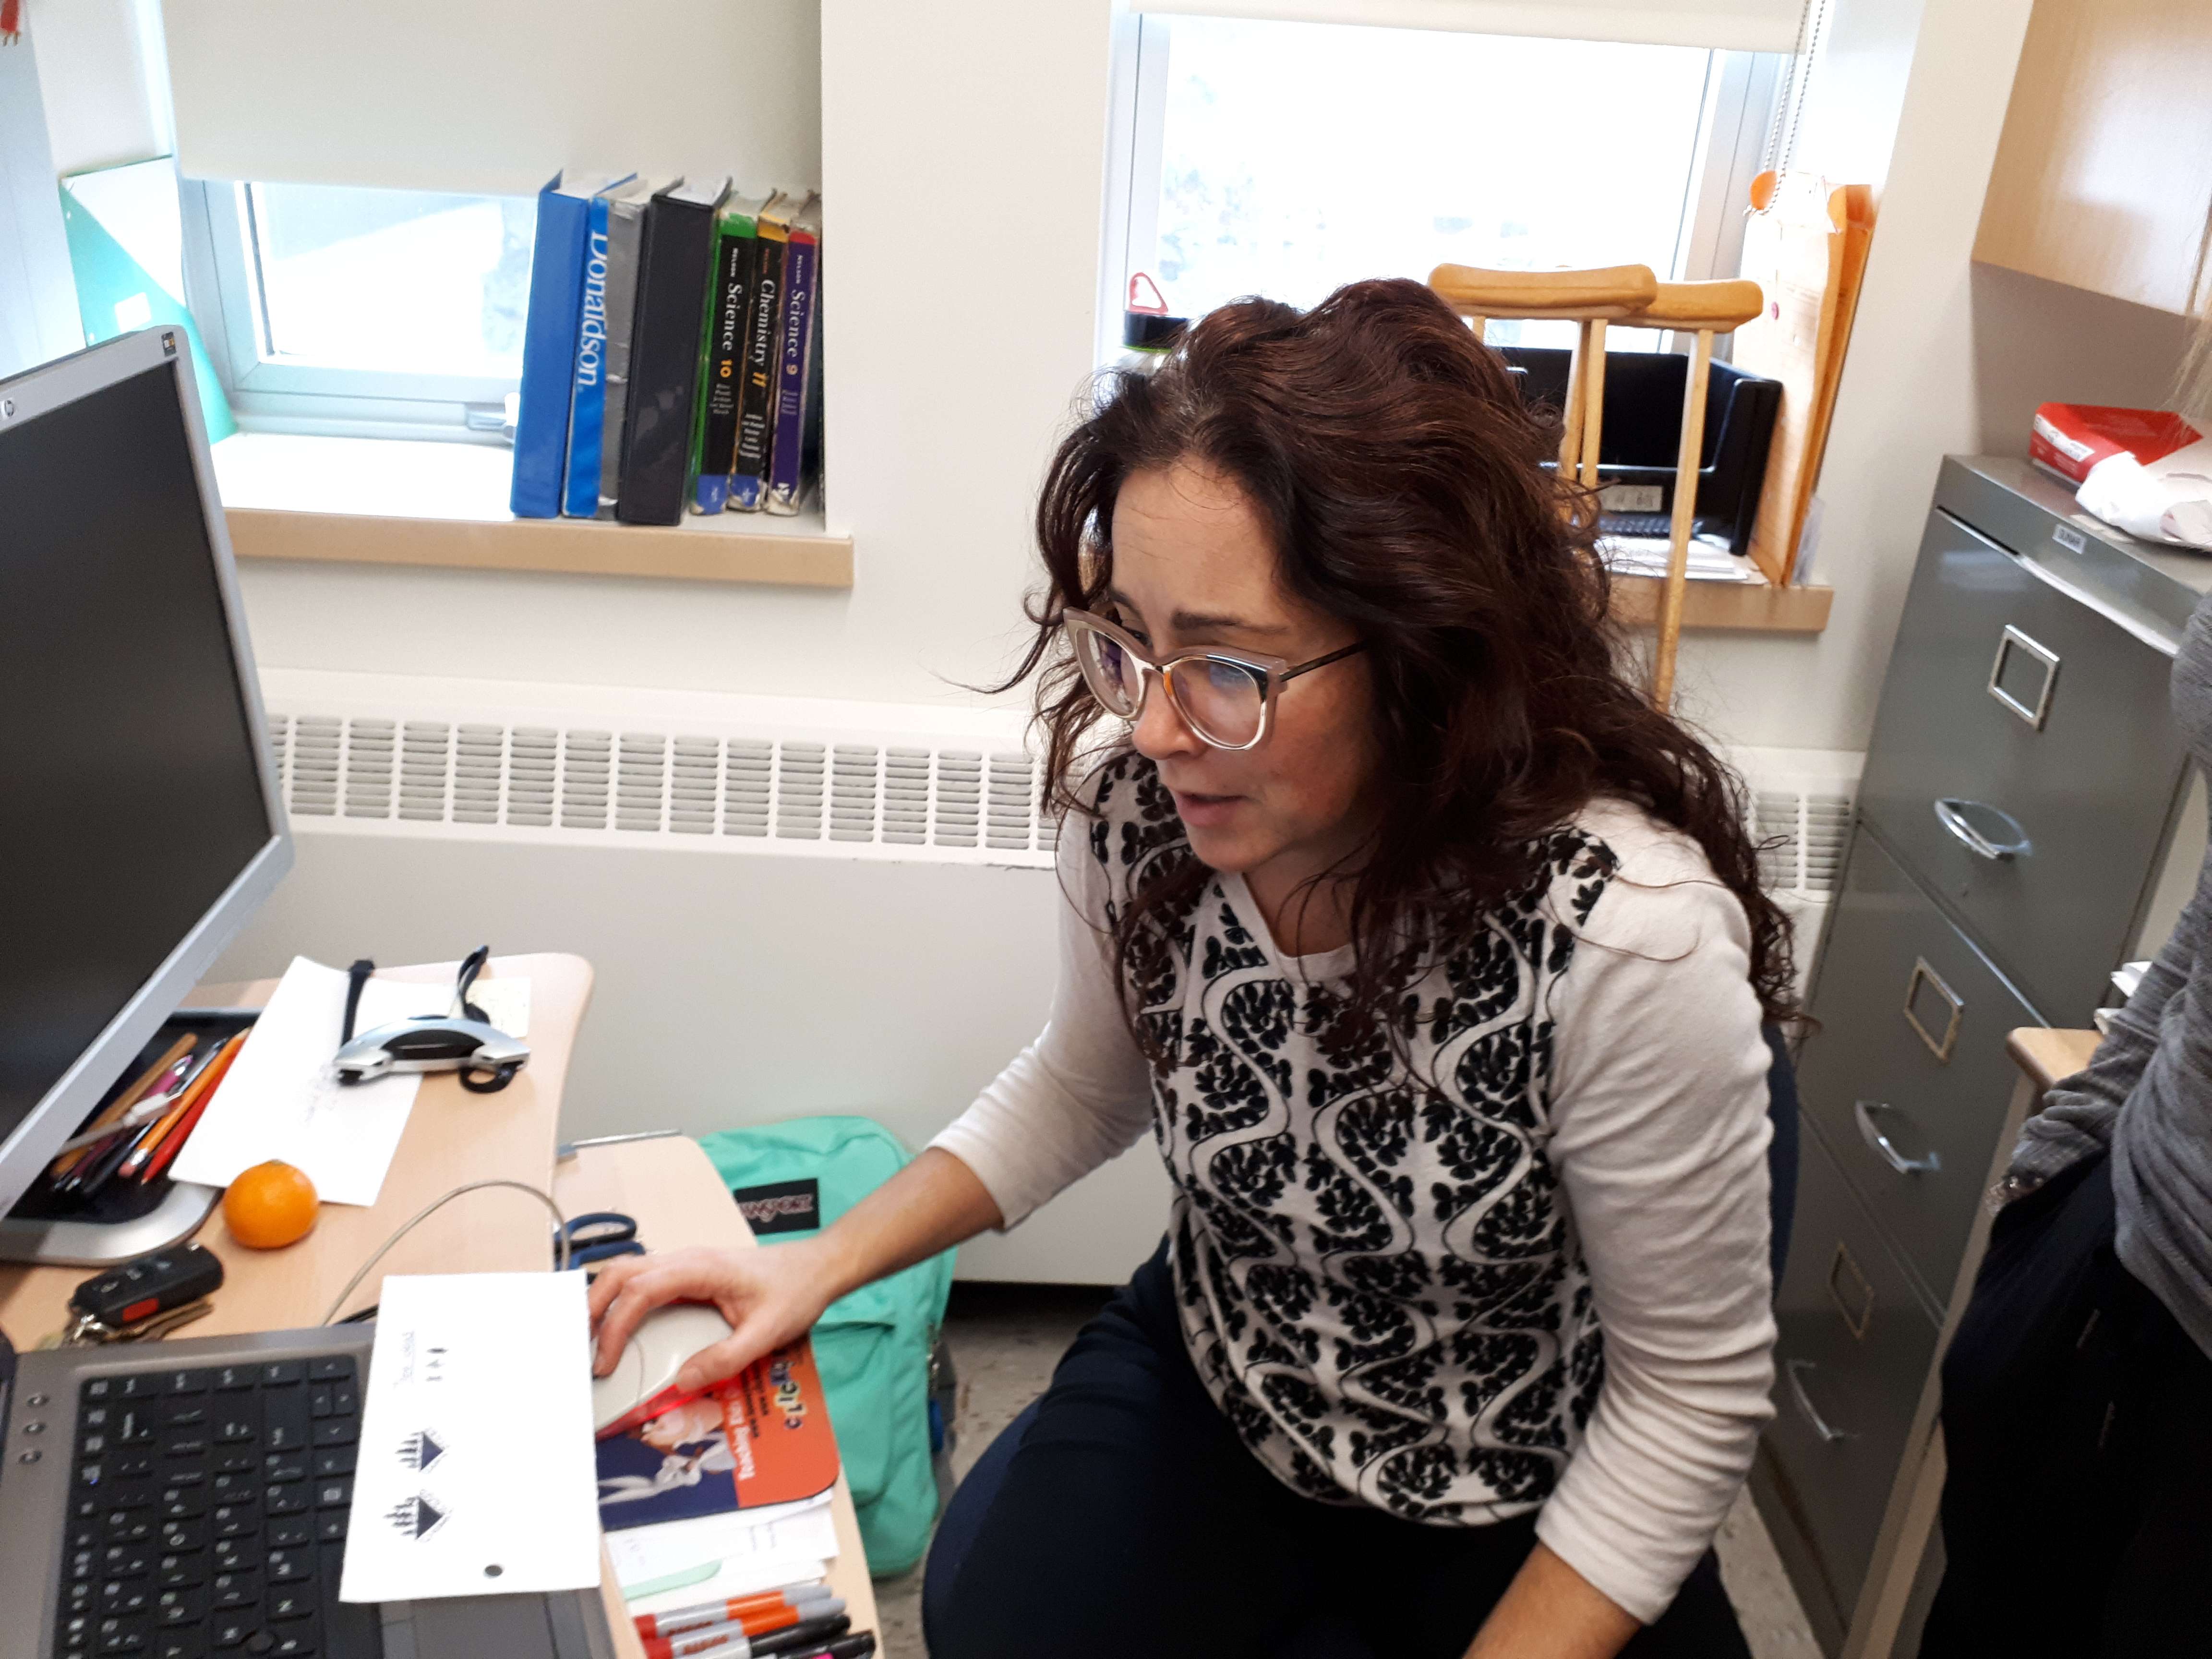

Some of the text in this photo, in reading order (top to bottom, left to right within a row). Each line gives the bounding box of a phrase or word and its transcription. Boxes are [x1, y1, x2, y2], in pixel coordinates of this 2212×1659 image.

[577, 231, 608, 385] Donaldson
[722, 282, 743, 351] Science
[748, 279, 776, 367] Chemistry
[787, 289, 806, 358] Science
[720, 360, 733, 378] 10
[752, 372, 769, 388] 11
[786, 363, 798, 375] 9
